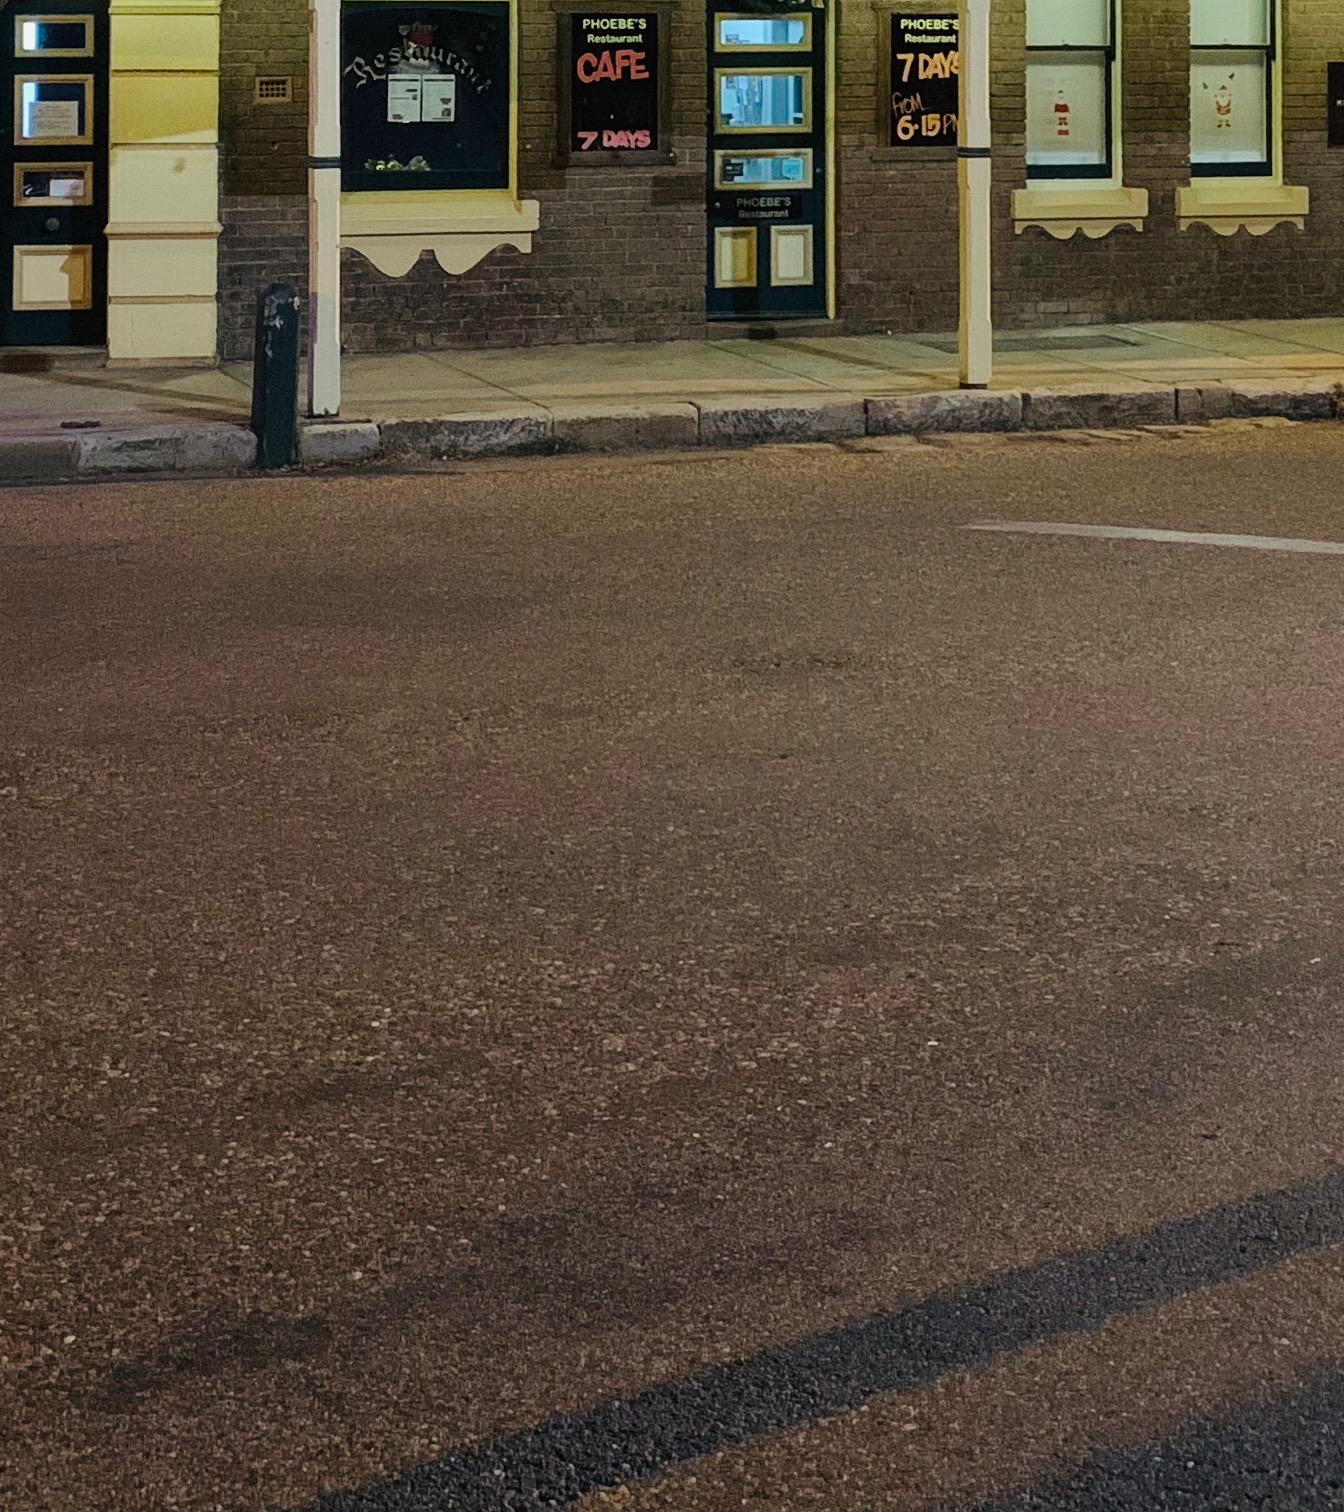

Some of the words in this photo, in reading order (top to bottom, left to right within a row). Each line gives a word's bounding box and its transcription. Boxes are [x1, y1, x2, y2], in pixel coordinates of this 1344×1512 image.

[582, 18, 647, 30] PHOEBE'S
[900, 18, 959, 30] PHOEBE'S
[587, 33, 643, 44] Restaurant
[905, 33, 956, 44] Restaurant
[577, 49, 650, 83] CAFE
[896, 53, 915, 83] 7
[577, 131, 598, 149] 7
[602, 130, 651, 149] DAYS
[737, 196, 791, 208] PHOEBE'S
